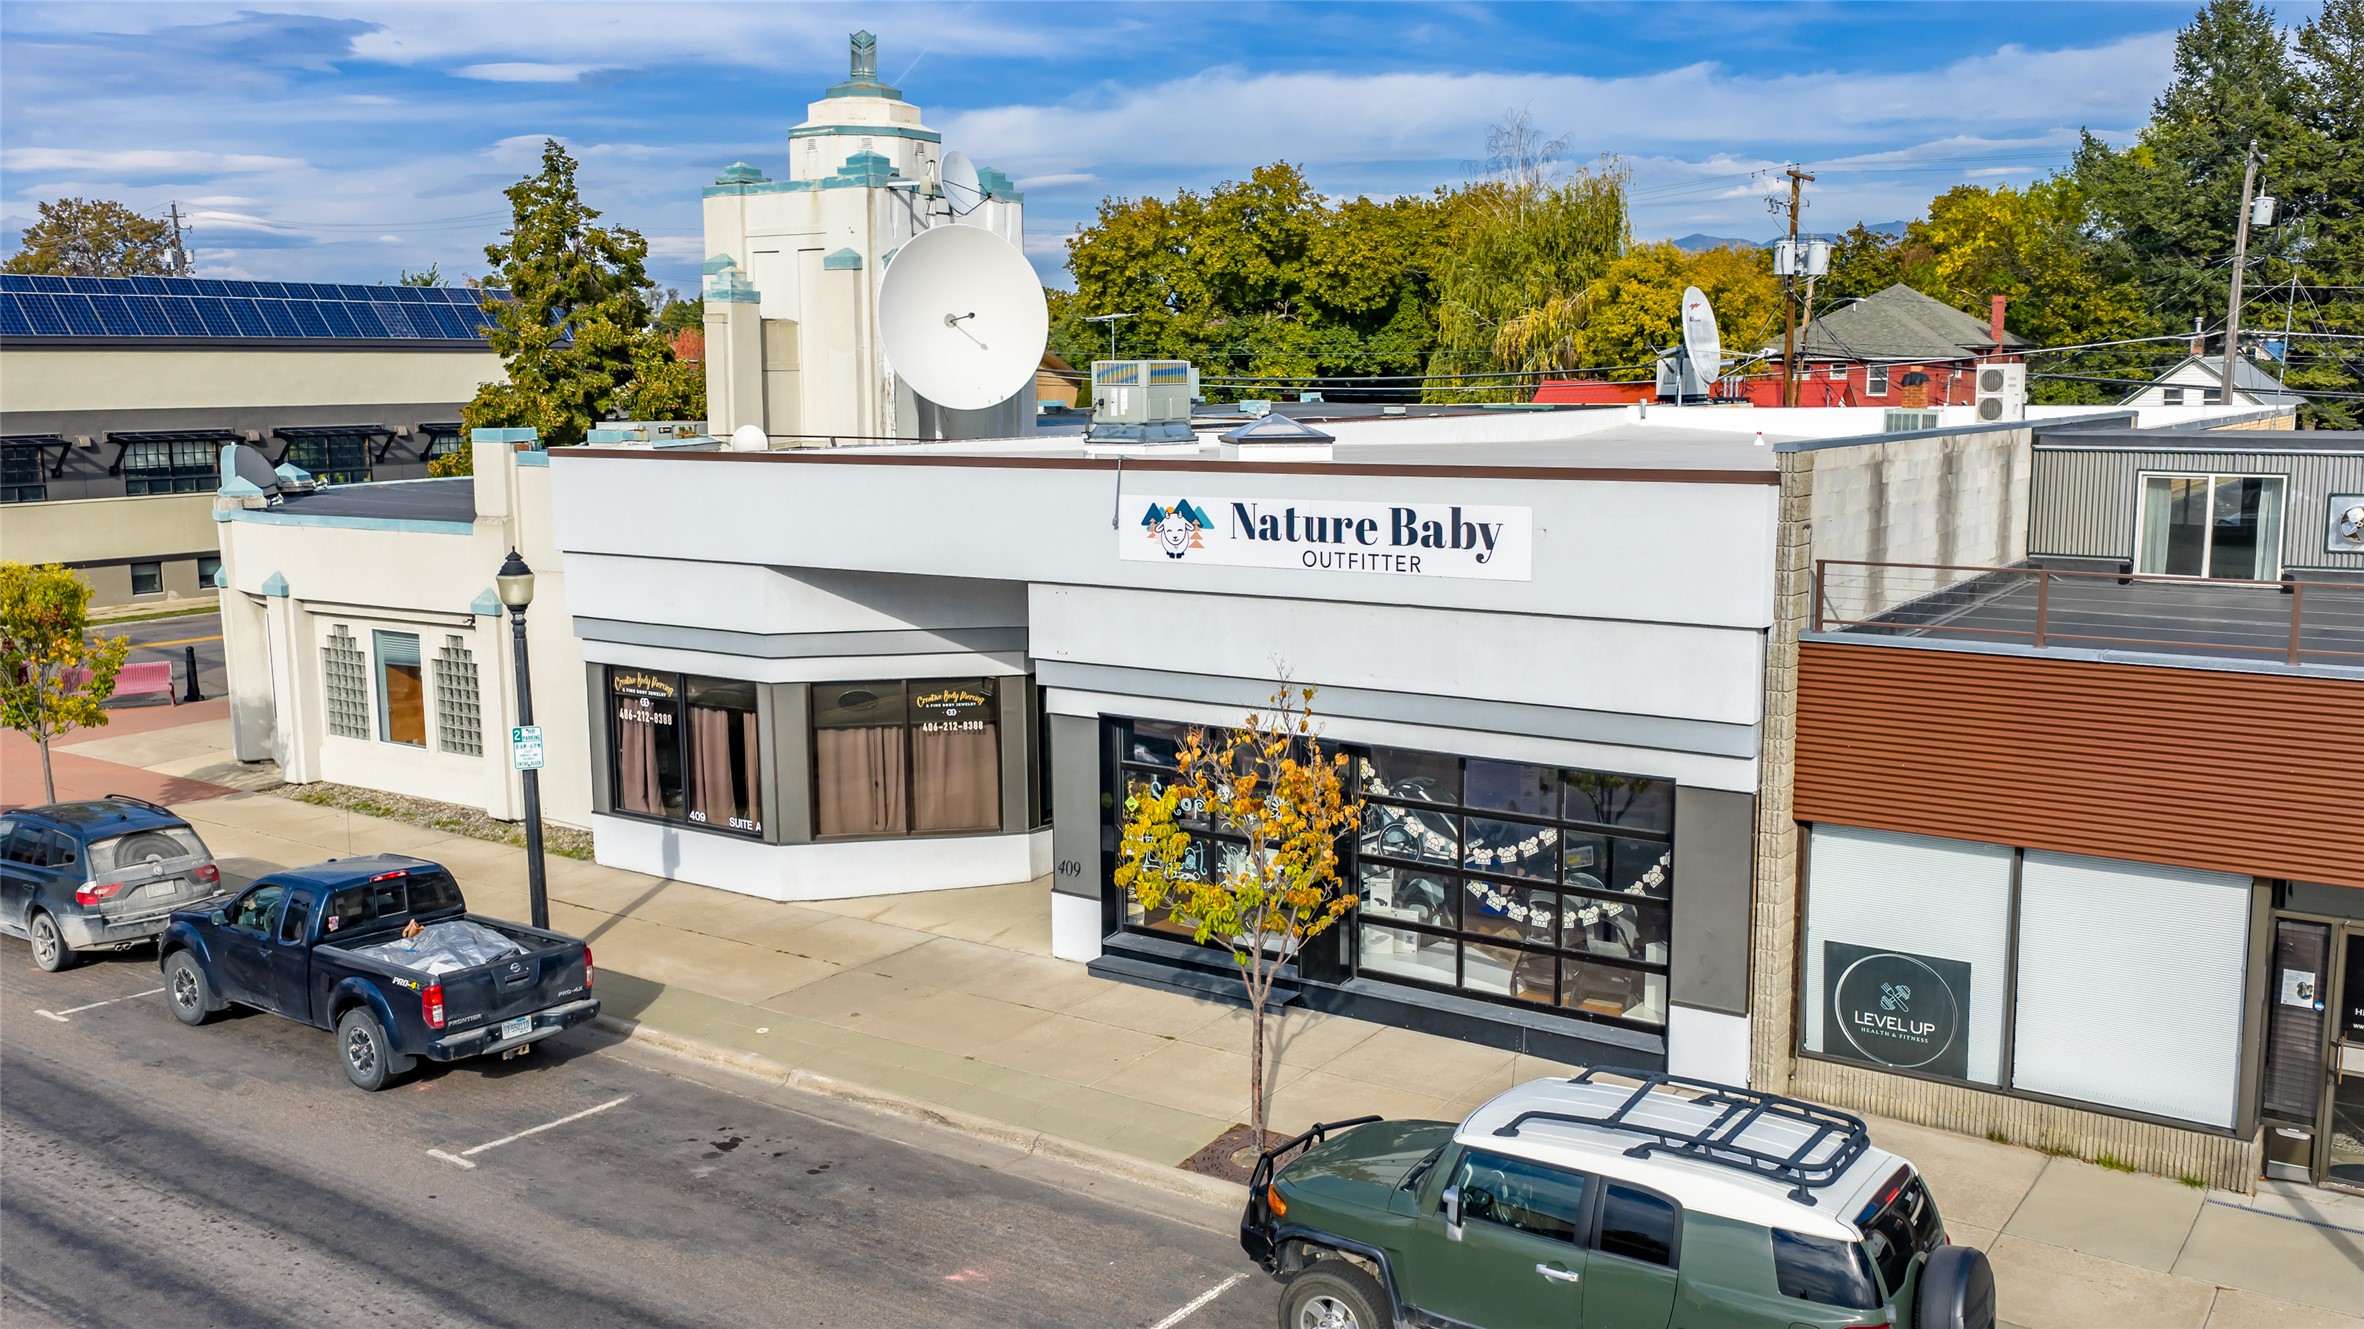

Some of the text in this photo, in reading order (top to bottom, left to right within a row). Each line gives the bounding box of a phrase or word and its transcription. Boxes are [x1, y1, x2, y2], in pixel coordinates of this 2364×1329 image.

[1230, 501, 1504, 564] Nature Baby
[1302, 550, 1421, 574] OUTFITTER
[615, 672, 674, 698] Creative Body Piercing
[917, 689, 985, 708] Creative Body Piercing
[513, 729, 521, 741] 2
[689, 810, 762, 832] 409 SUITE A
[1058, 860, 1081, 878] 409
[447, 1013, 482, 1028] FRONTIER
[1854, 1010, 1936, 1036] LEVEL UP
[1861, 1027, 1890, 1037] HEALTH
[1898, 1033, 1929, 1044] FITNESS
